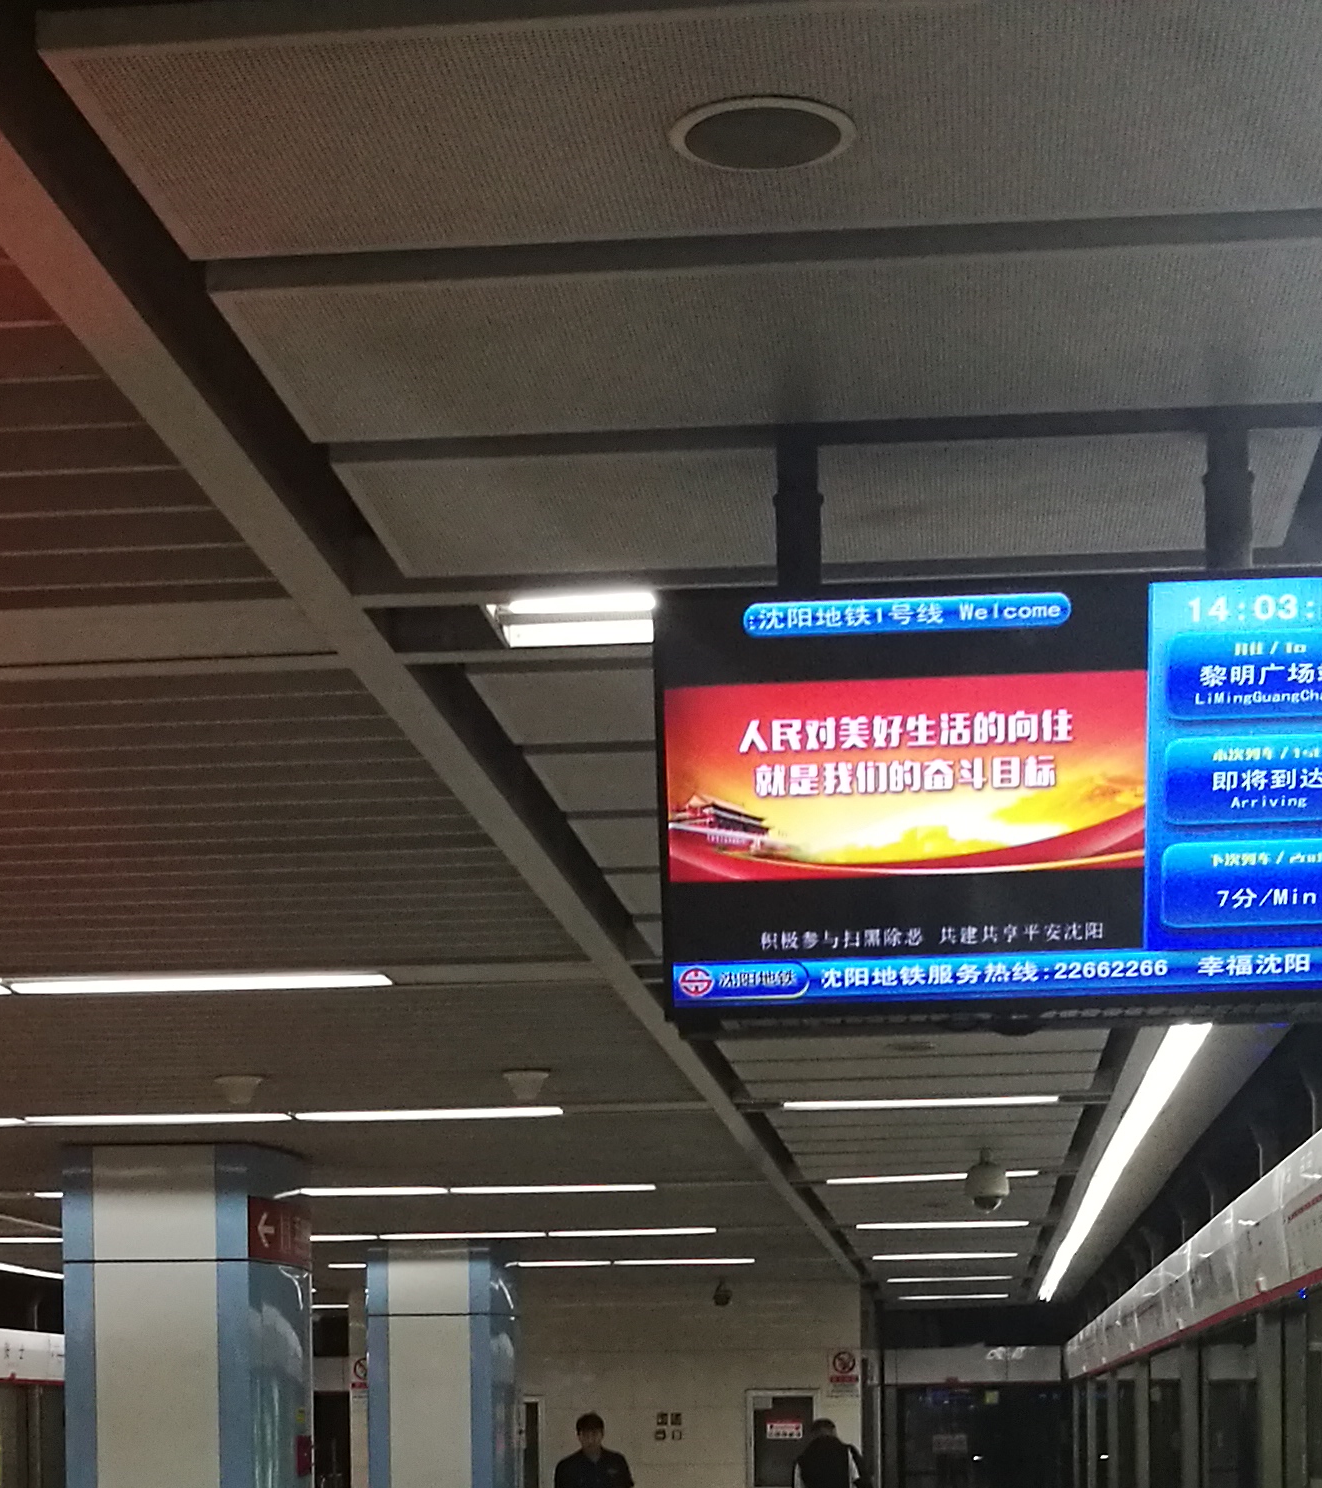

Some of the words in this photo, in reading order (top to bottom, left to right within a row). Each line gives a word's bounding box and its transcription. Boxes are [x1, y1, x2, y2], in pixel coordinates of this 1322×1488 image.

[959, 602, 1062, 623] Welcome
[737, 707, 1075, 754] 人民对美好生活的向往
[753, 754, 1058, 798] 就是我们的奋斗目标
[1230, 794, 1309, 810] Arriving
[1196, 950, 1312, 977] 幸福沈阳
